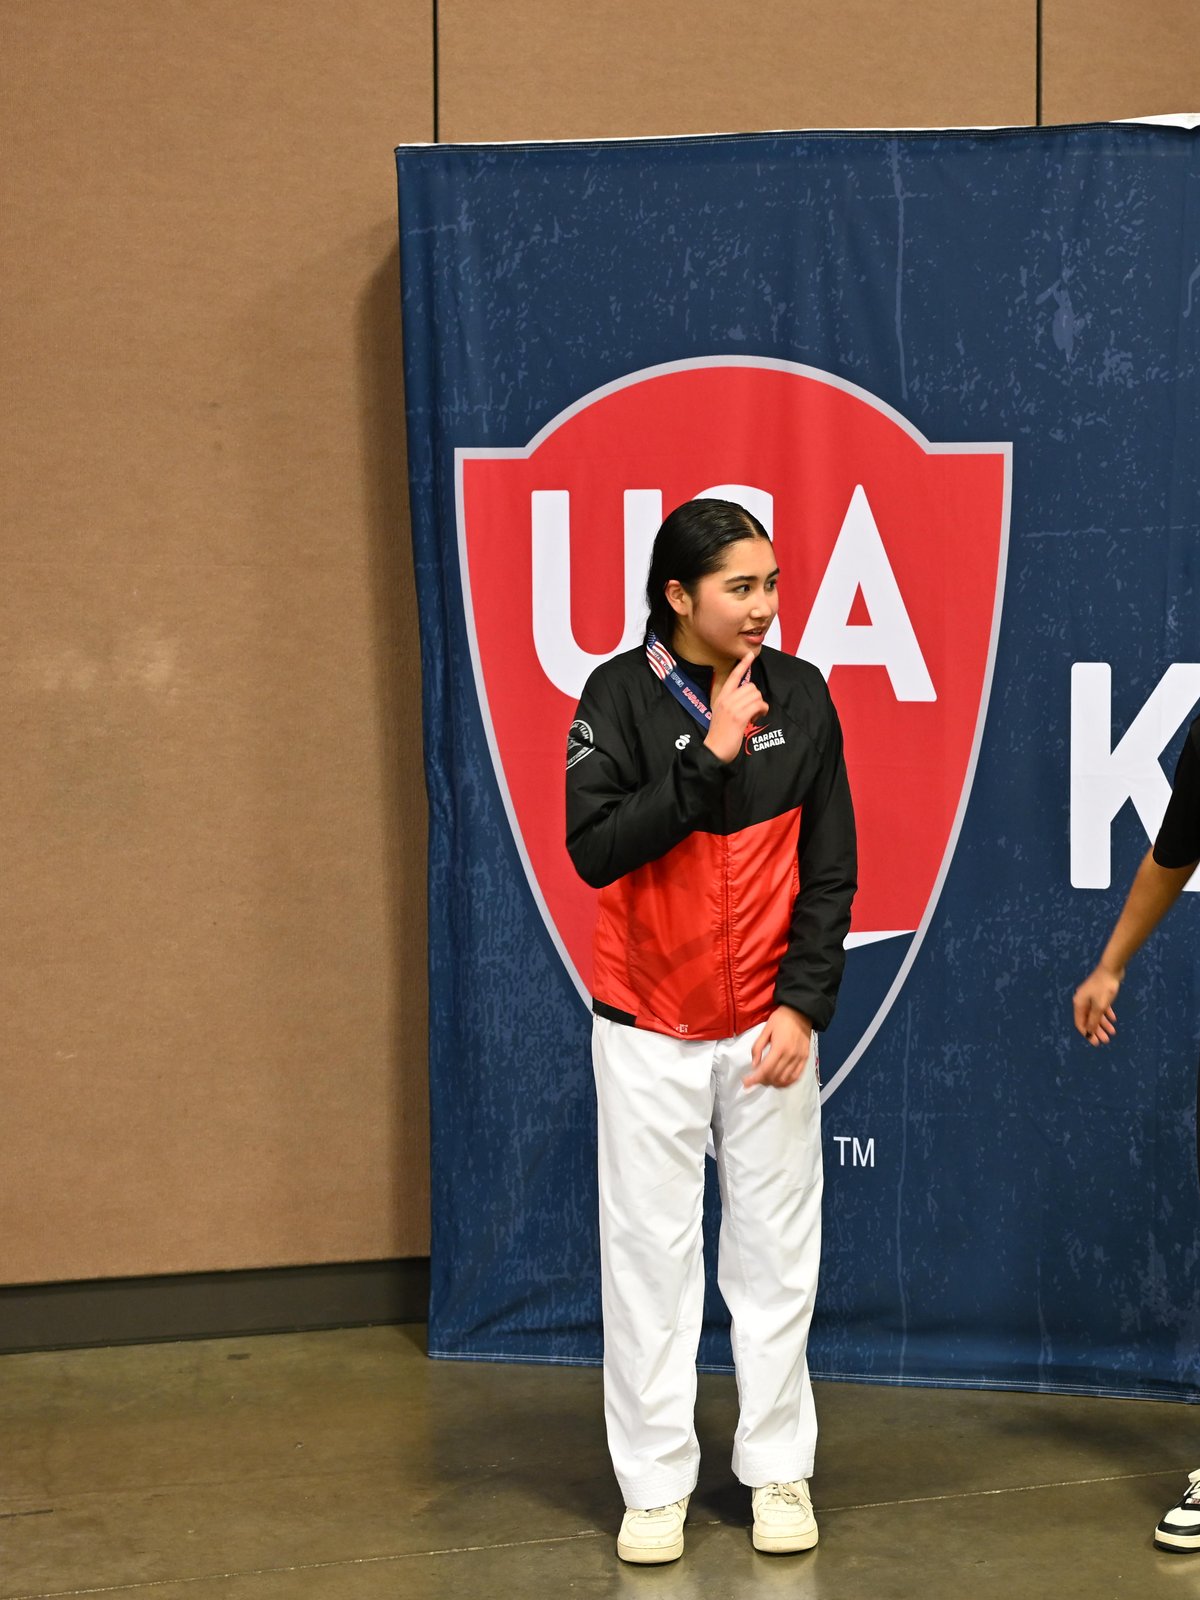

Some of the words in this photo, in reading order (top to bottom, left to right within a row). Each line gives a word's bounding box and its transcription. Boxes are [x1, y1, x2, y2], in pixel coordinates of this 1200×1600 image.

[531, 484, 938, 702] UA
[682, 686, 708, 714] KARATE
[751, 729, 784, 744] KARATE
[753, 736, 786, 752] CANADA
[833, 1136, 875, 1168] TM
